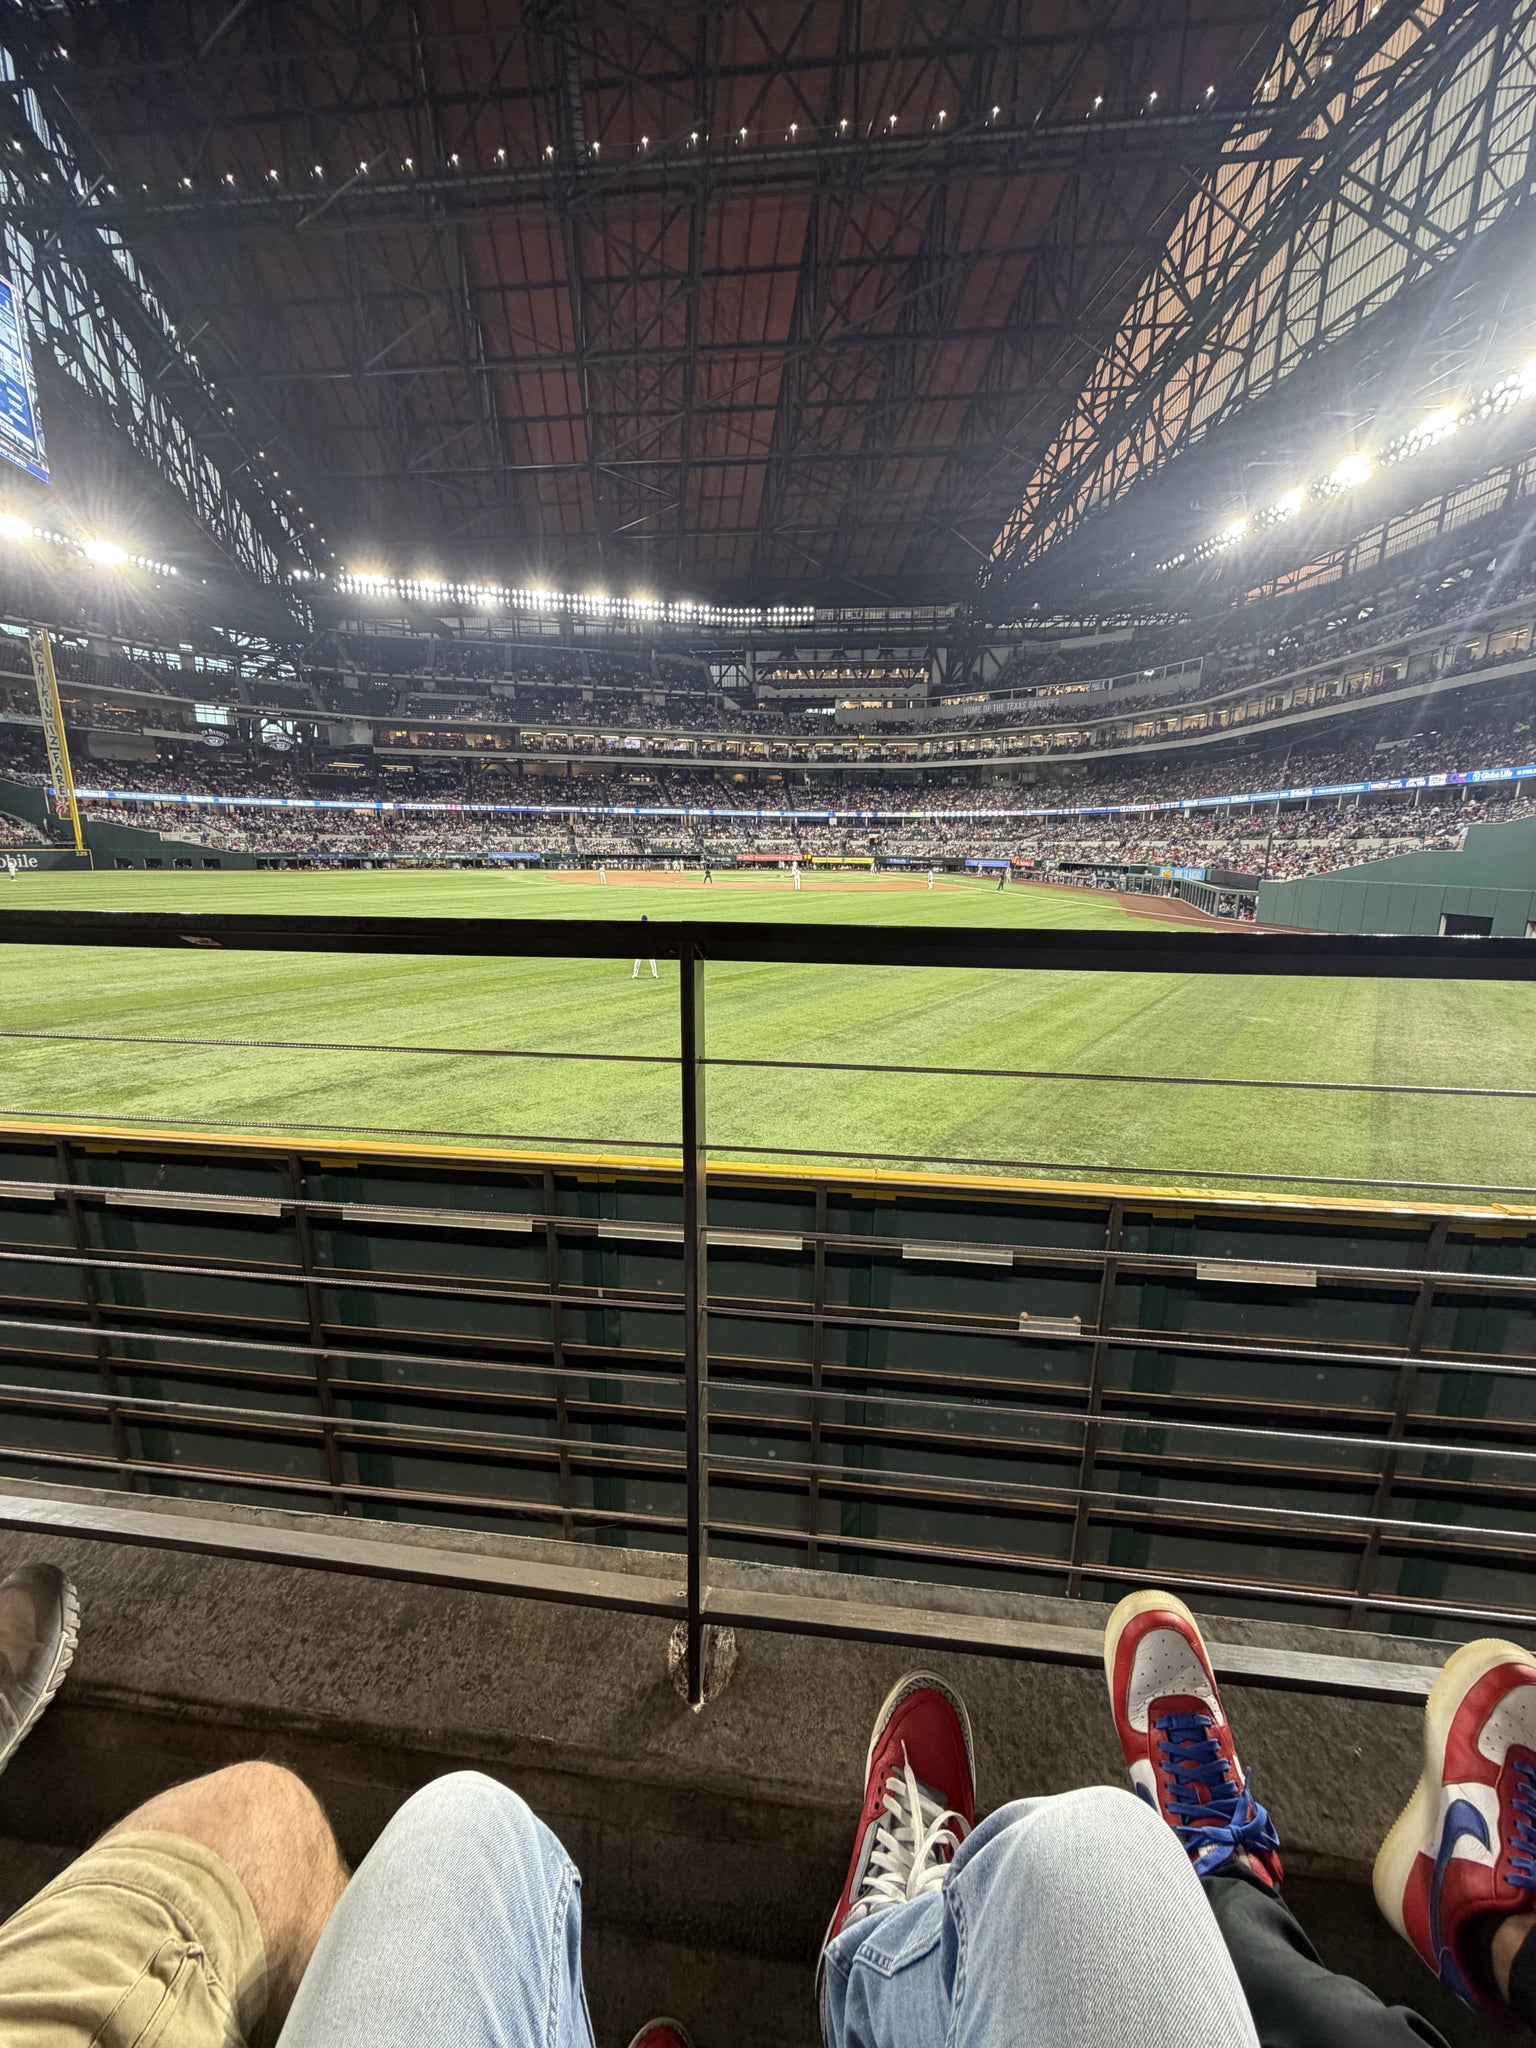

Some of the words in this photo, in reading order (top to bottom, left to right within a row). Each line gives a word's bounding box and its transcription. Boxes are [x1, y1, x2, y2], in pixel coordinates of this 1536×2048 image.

[963, 705, 981, 715] HOME
[983, 704, 992, 713] OF
[993, 703, 1005, 712] THE
[1006, 701, 1027, 712] TEXAS
[1028, 698, 1060, 709] RANGERS
[52, 752, 66, 795] FARE
[1481, 771, 1500, 779] Globe
[1500, 769, 1513, 777] Life
